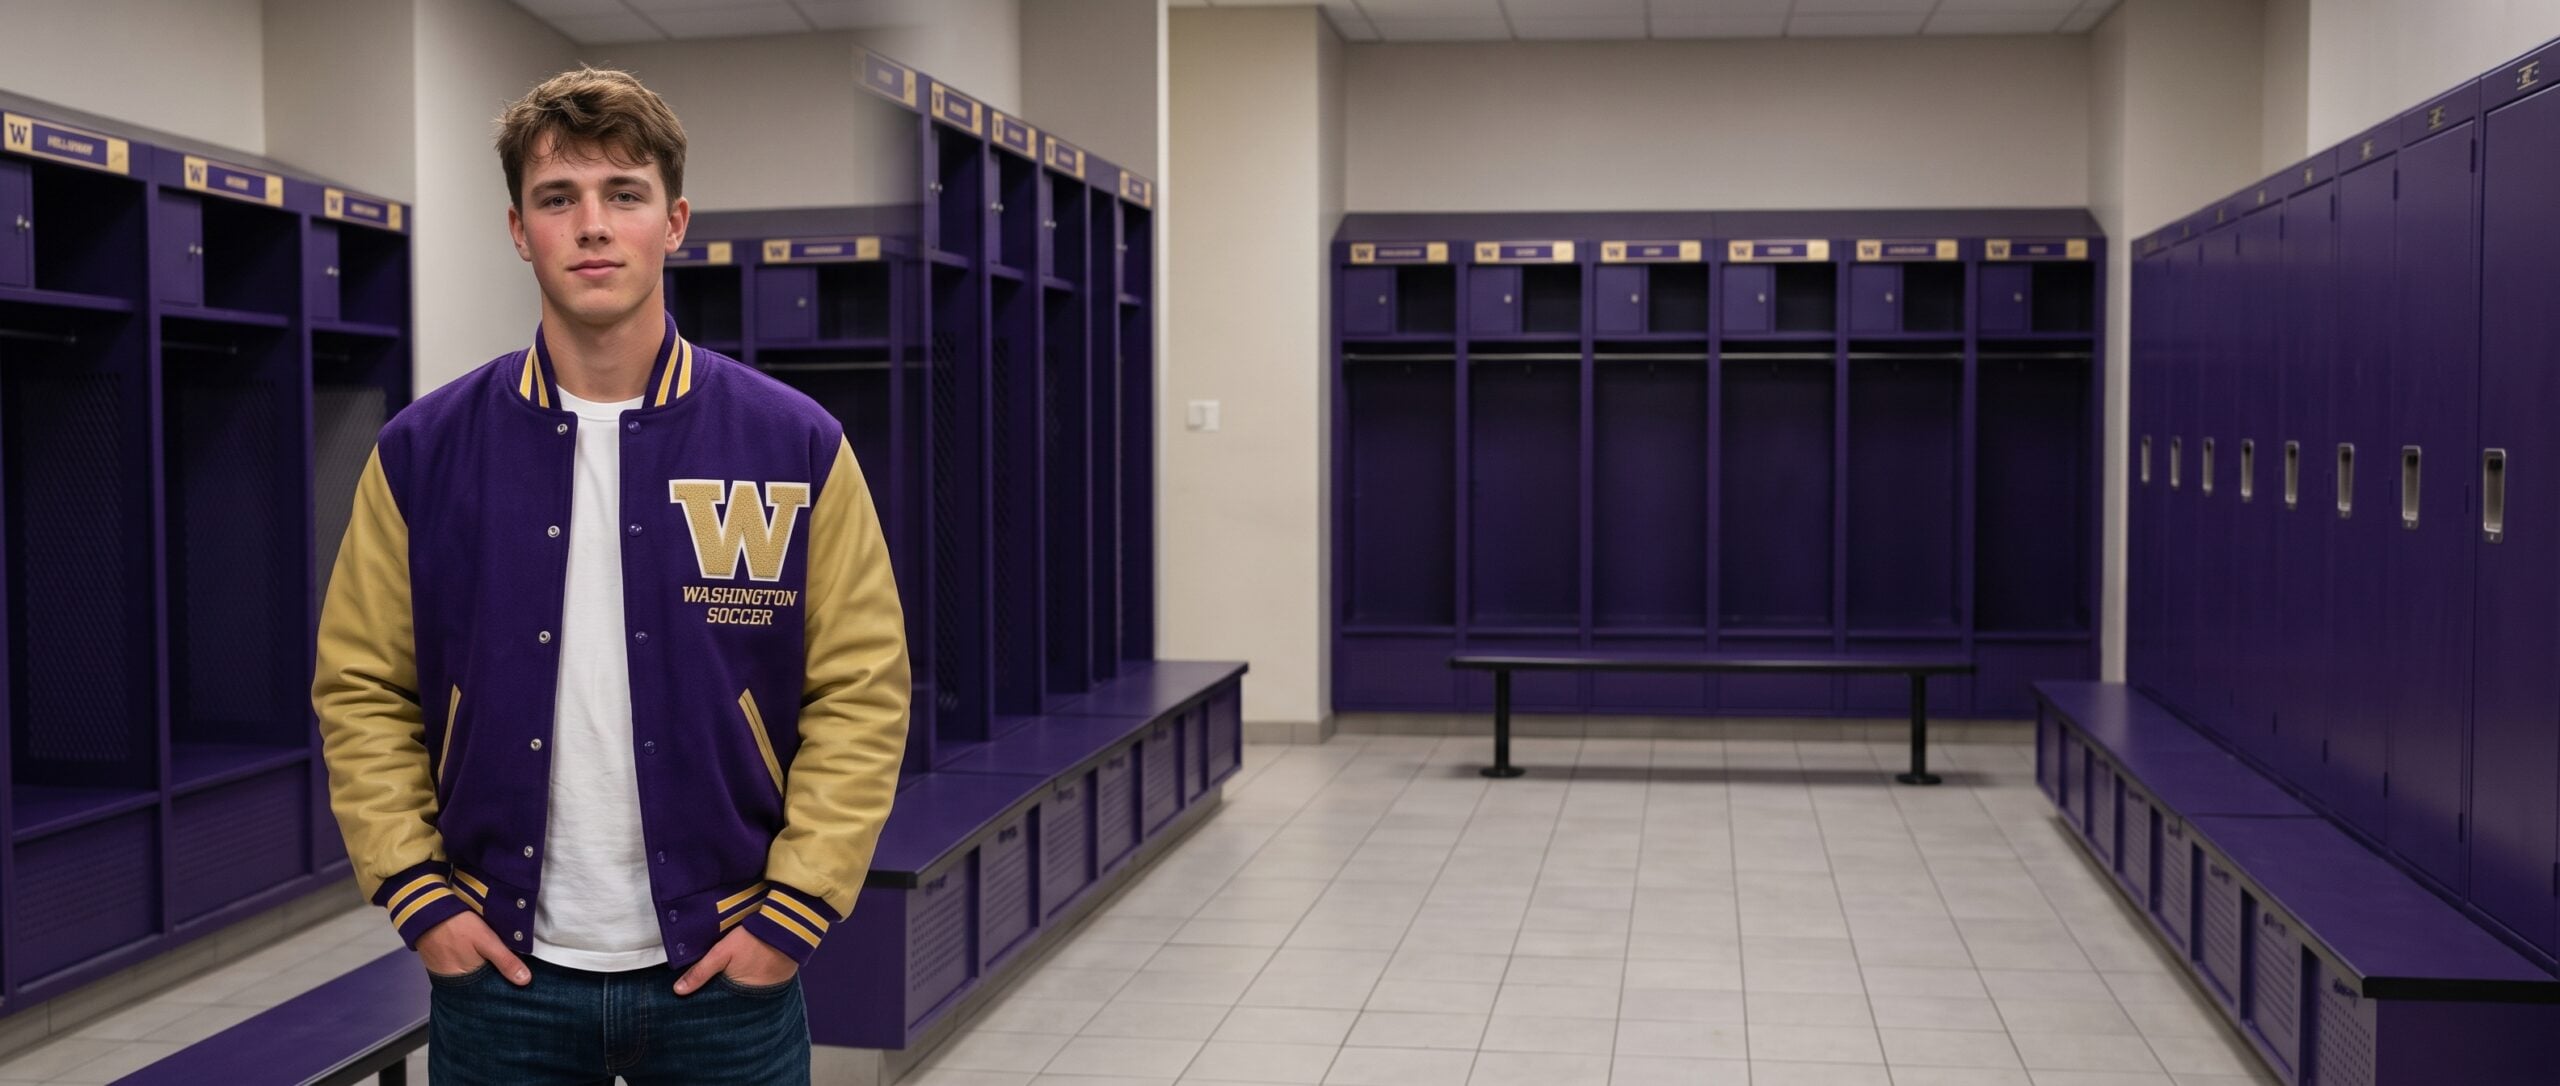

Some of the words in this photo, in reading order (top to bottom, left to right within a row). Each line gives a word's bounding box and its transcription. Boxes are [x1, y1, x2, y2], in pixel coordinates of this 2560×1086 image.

[9, 123, 27, 145] W
[189, 165, 203, 183] W
[768, 246, 786, 258] W
[1355, 247, 1371, 259] W
[1480, 247, 1496, 257] W
[1606, 247, 1622, 257] W
[1733, 246, 1749, 256] W
[1861, 244, 1877, 255] W
[1990, 243, 2006, 255] W
[669, 479, 811, 582] W
[682, 586, 798, 607] WASHINGTON
[706, 607, 774, 625] SOCCER
